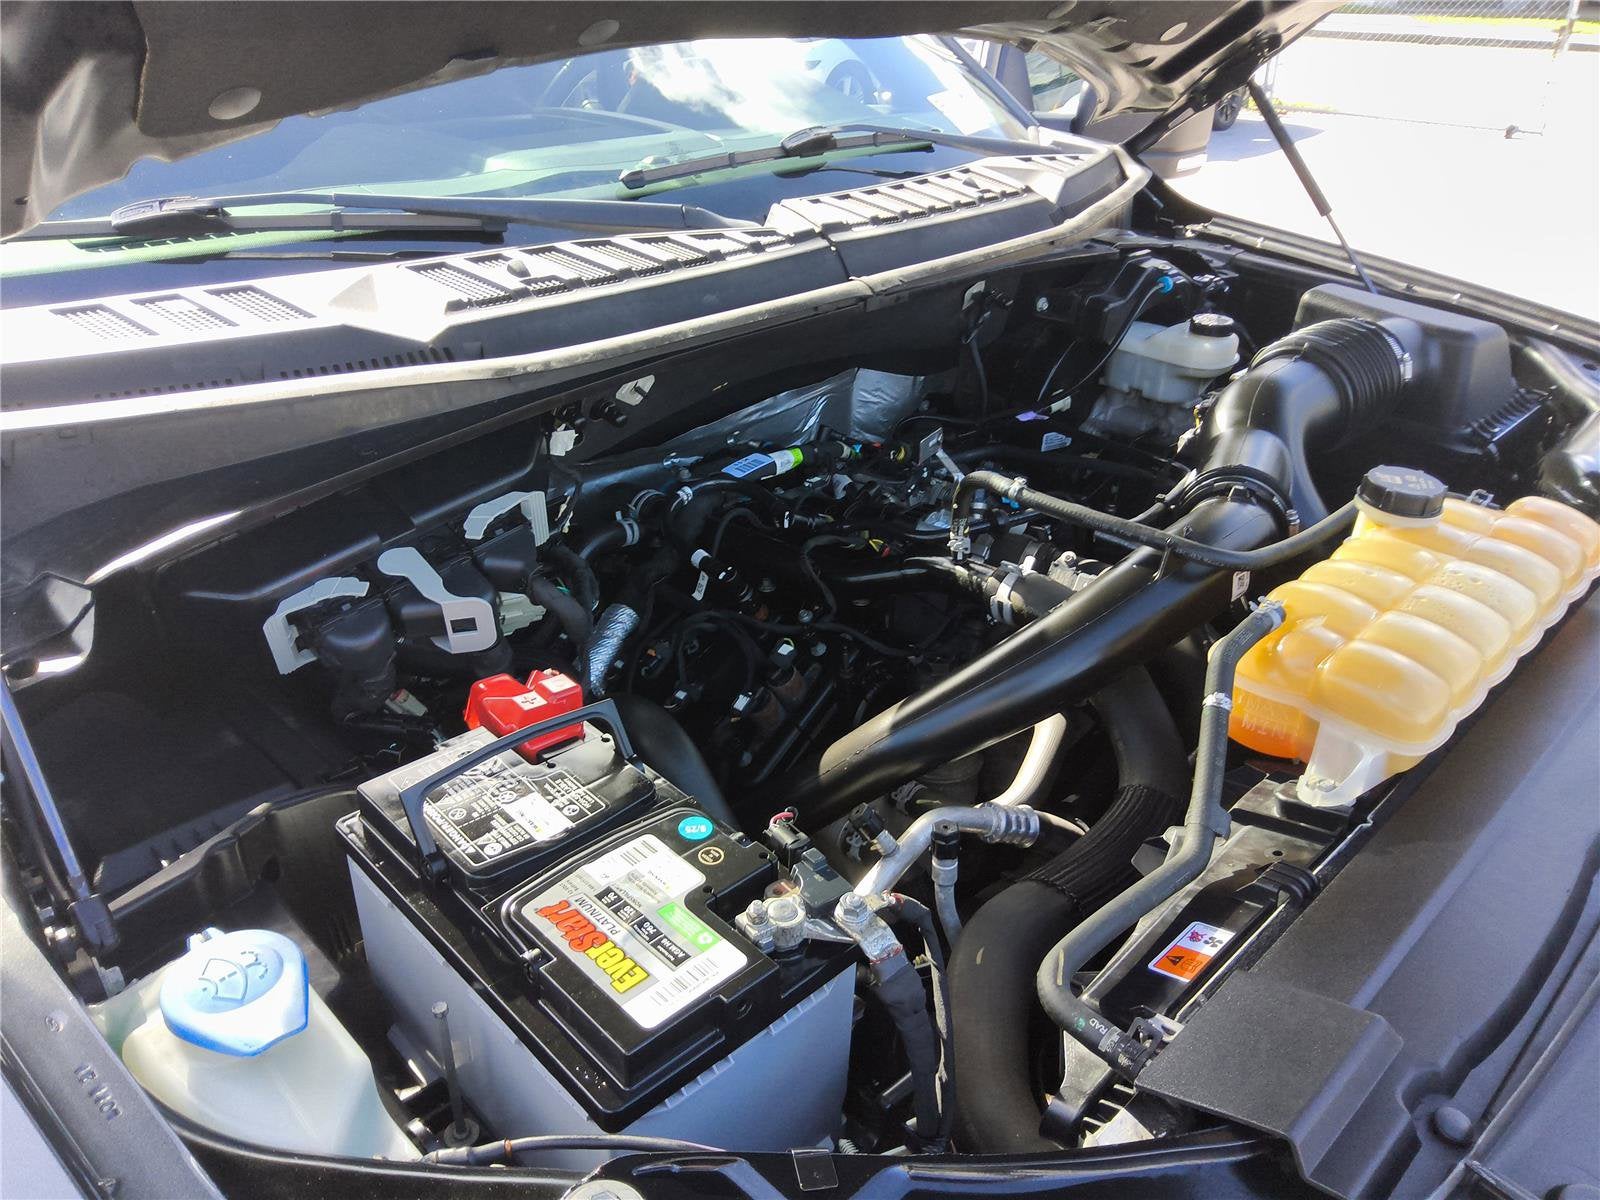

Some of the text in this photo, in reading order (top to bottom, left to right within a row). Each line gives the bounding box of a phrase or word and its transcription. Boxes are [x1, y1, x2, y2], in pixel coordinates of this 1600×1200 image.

[607, 891, 617, 900] 70
[574, 895, 620, 935] PLATINUM
[623, 905, 635, 915] 120
[643, 920, 656, 933] 760
[534, 898, 650, 995] EverStart
[668, 944, 685, 957] AGM
[1087, 1017, 1108, 1034] RAD
